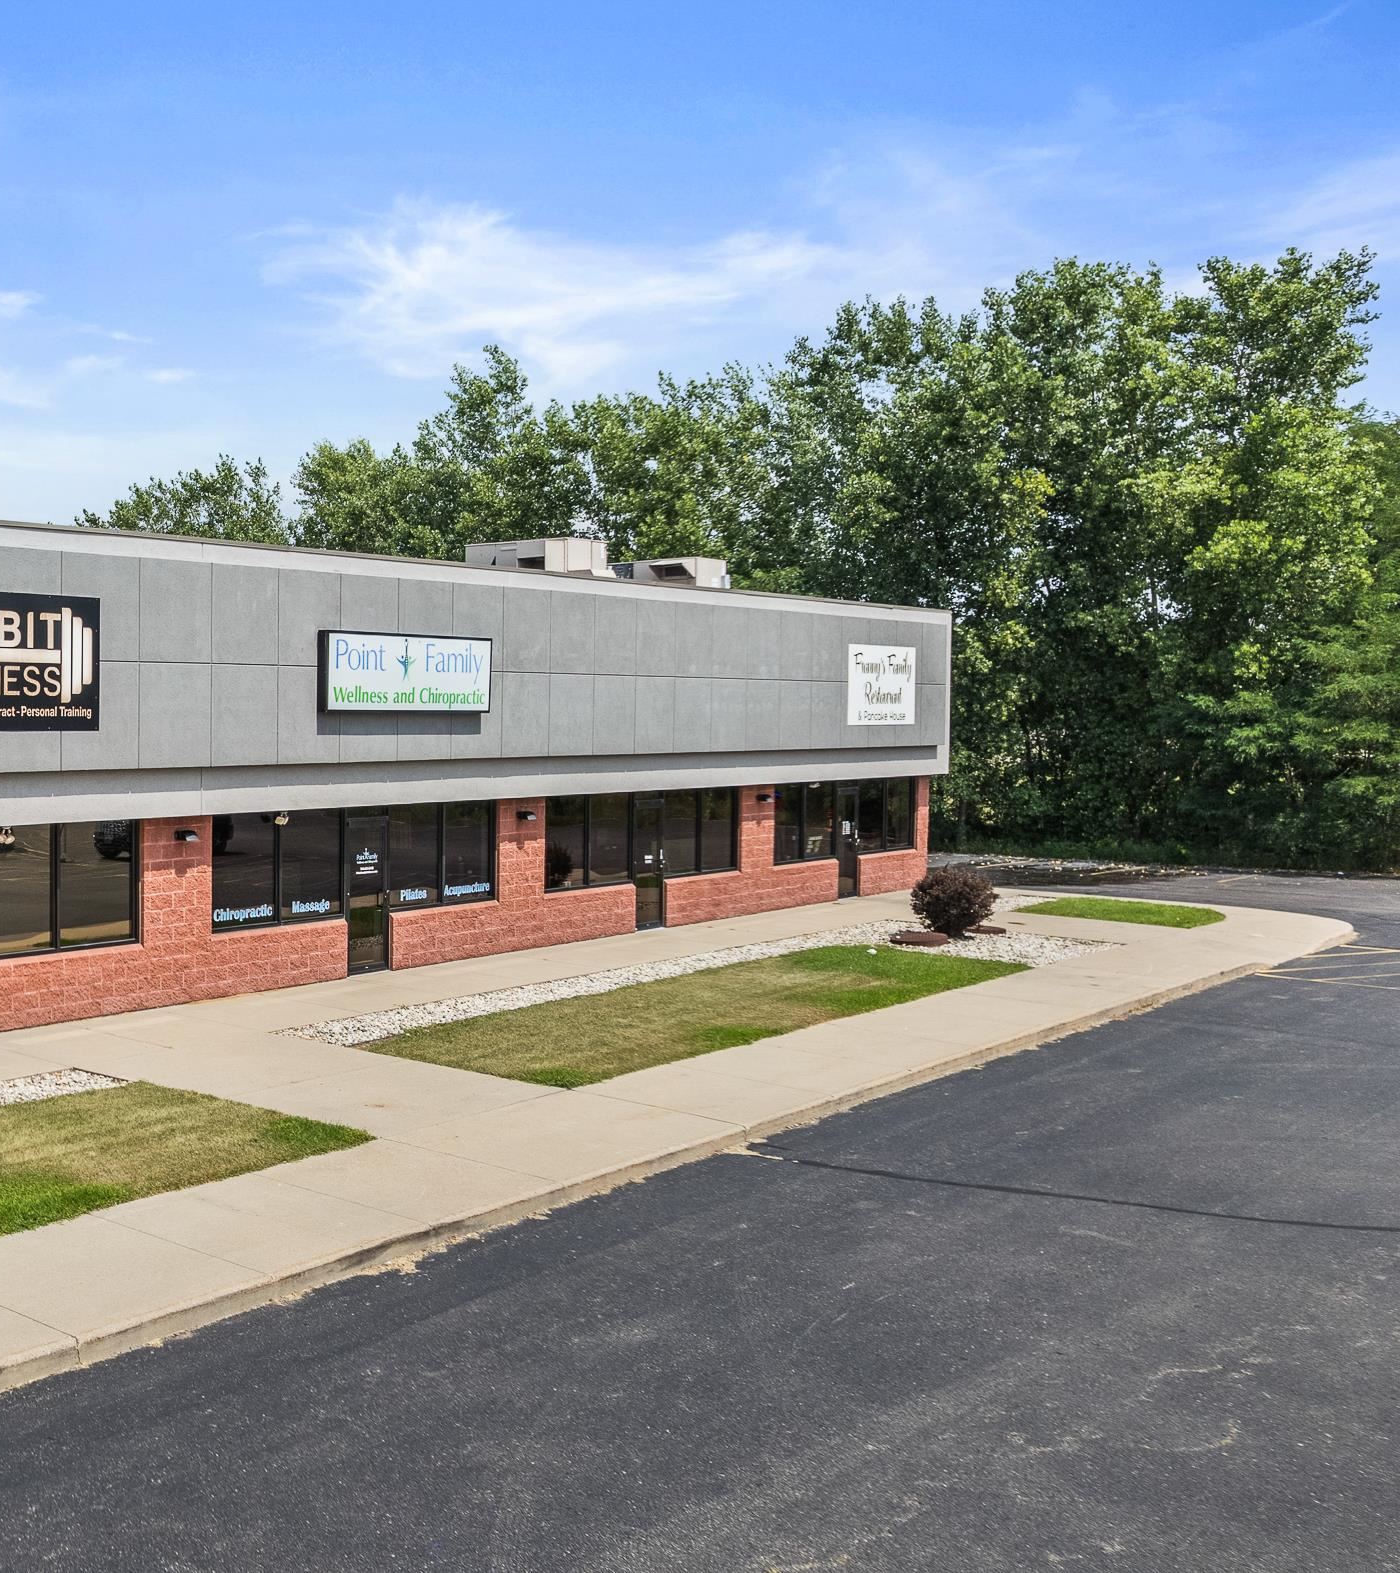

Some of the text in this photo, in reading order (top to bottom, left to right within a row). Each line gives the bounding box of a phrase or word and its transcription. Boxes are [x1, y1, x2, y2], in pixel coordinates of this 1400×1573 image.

[335, 639, 483, 685] Point Family
[887, 651, 912, 683] Family
[333, 685, 486, 709] Wellness and Chiropractic
[59, 705, 92, 720] Training
[400, 888, 428, 902] Pilates
[443, 881, 490, 897] Acupuncture
[213, 903, 273, 922] Chiropractic
[292, 898, 330, 914] Massage
